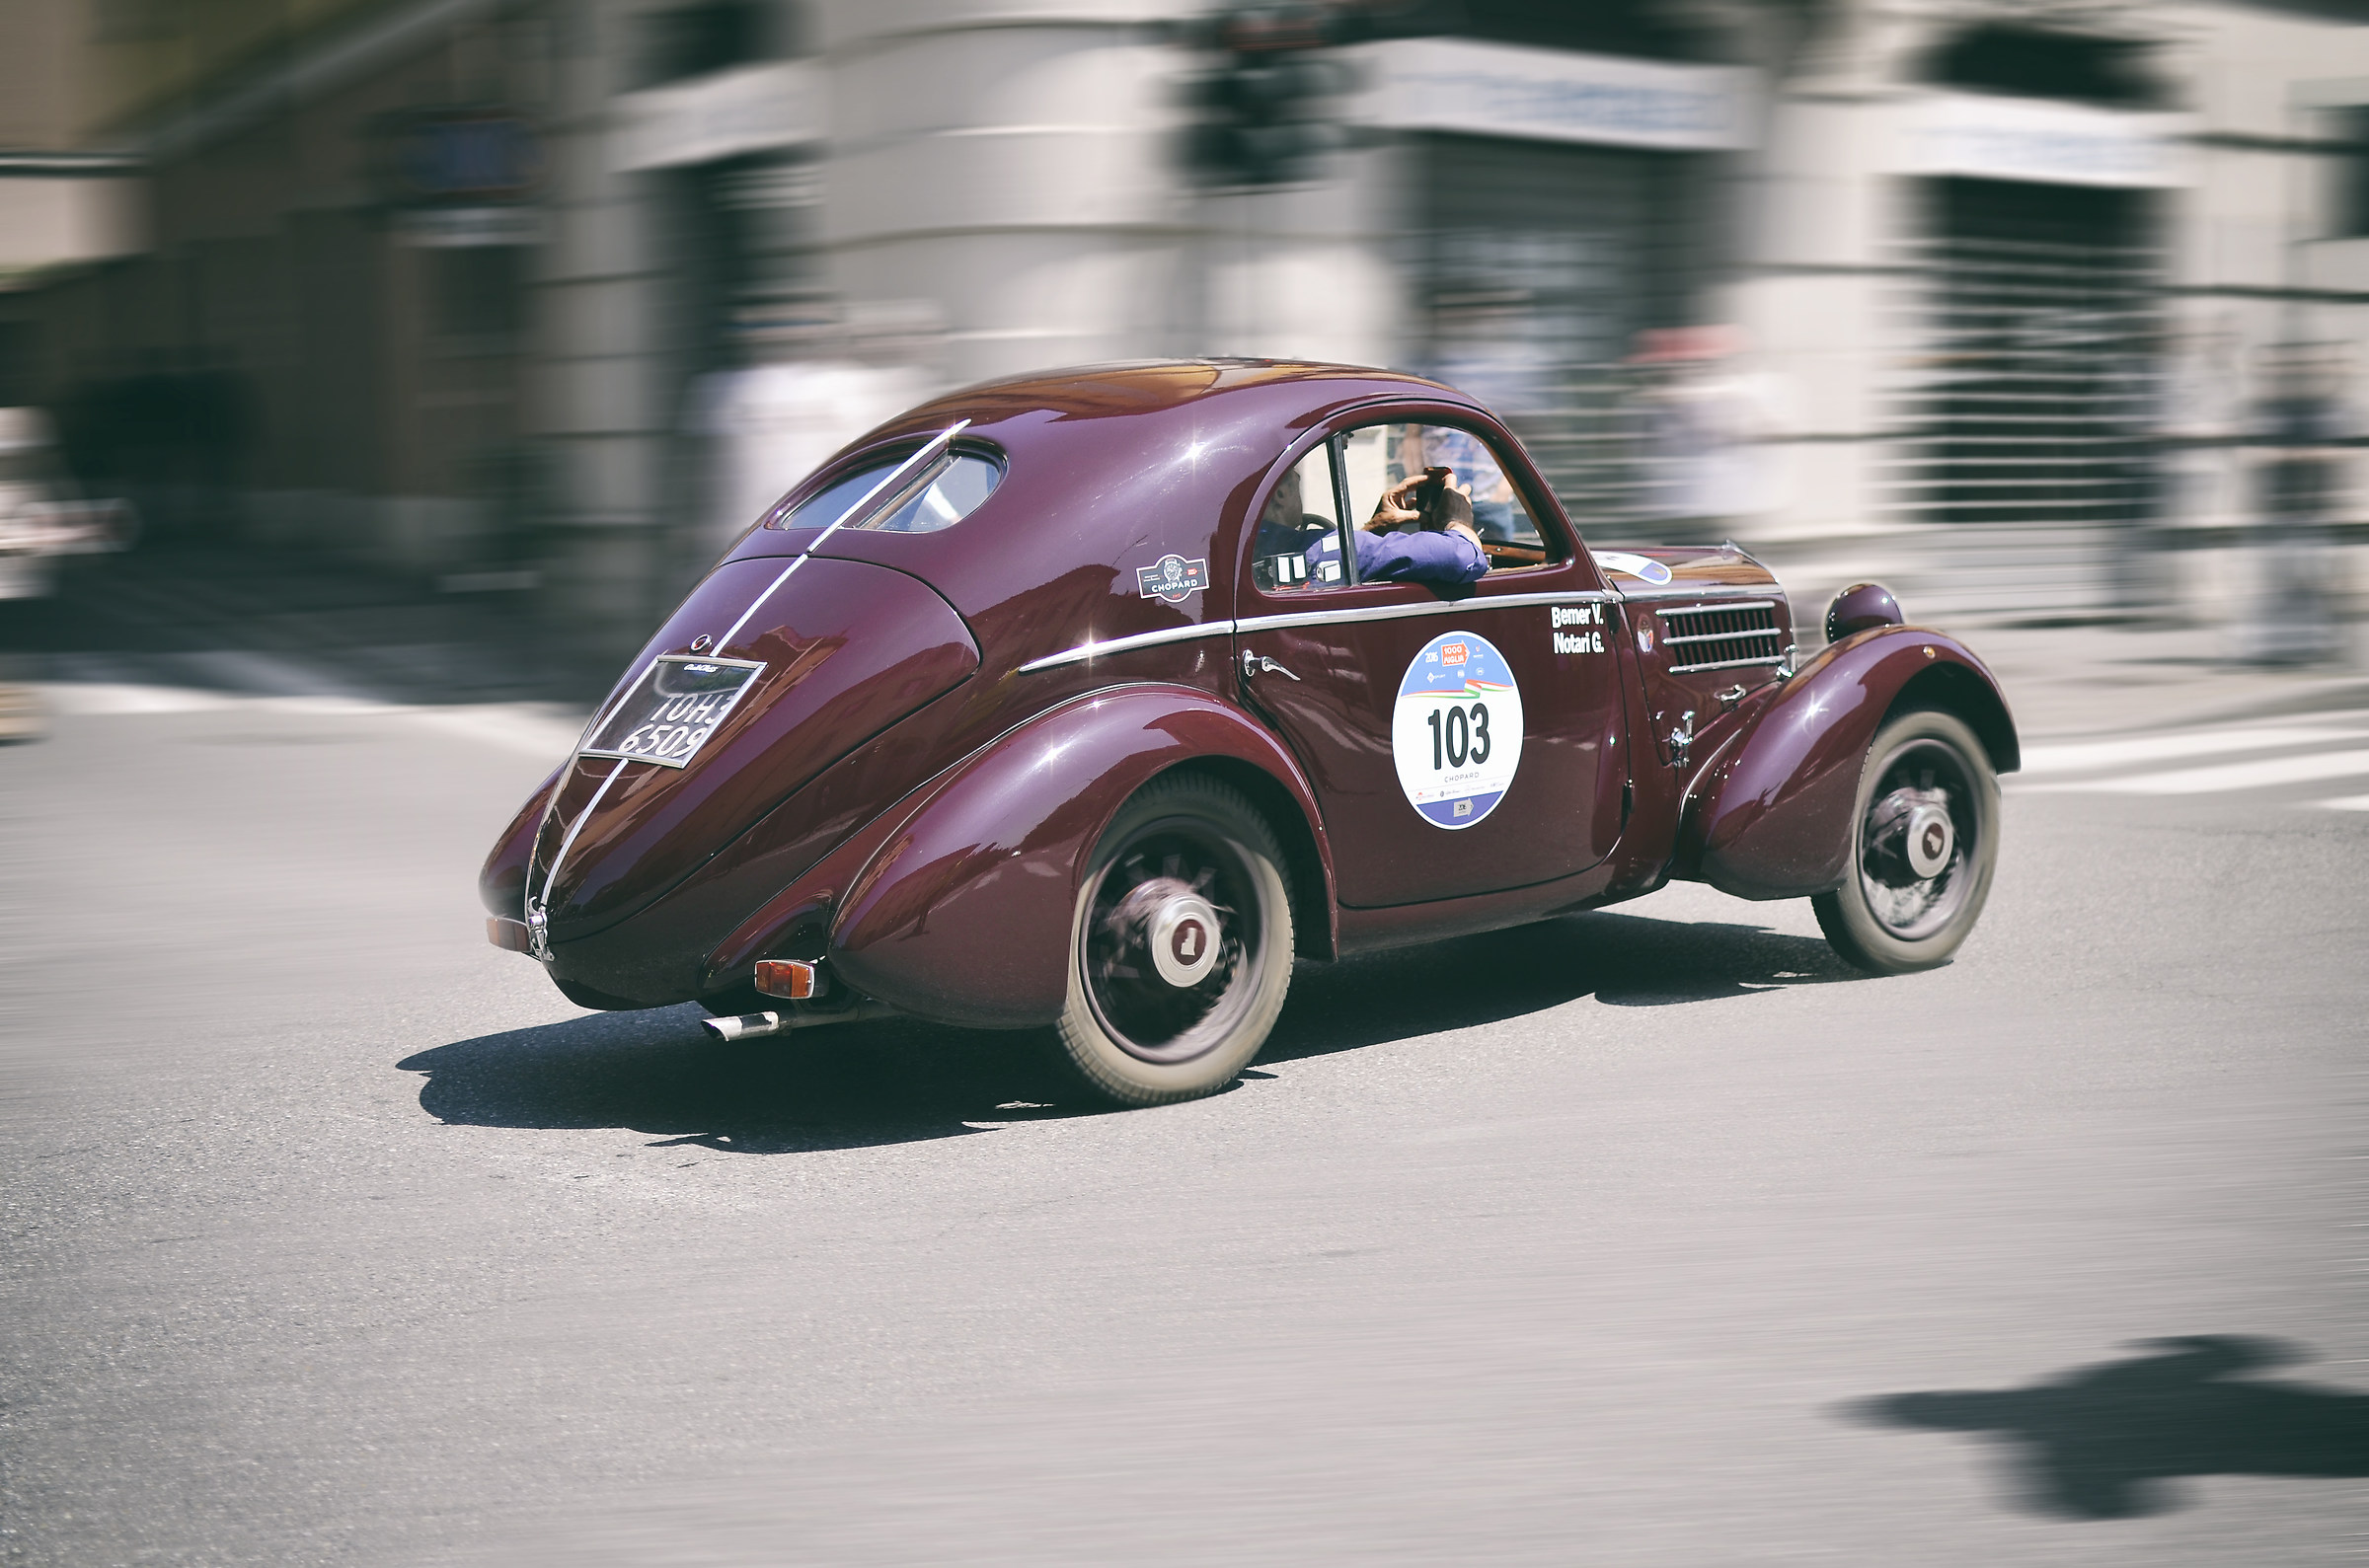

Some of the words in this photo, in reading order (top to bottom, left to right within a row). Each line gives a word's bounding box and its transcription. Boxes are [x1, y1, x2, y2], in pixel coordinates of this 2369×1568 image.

[1151, 579, 1198, 593] CHOPARD
[1591, 603, 1604, 625] V.
[1443, 645, 1463, 655] 1000
[1553, 632, 1590, 654] Notari
[1591, 632, 1605, 653] G.
[1443, 655, 1465, 664] MIGLIA
[618, 723, 708, 758] 6509
[1427, 703, 1490, 770] 103
[1444, 772, 1480, 784] CHOPARD
